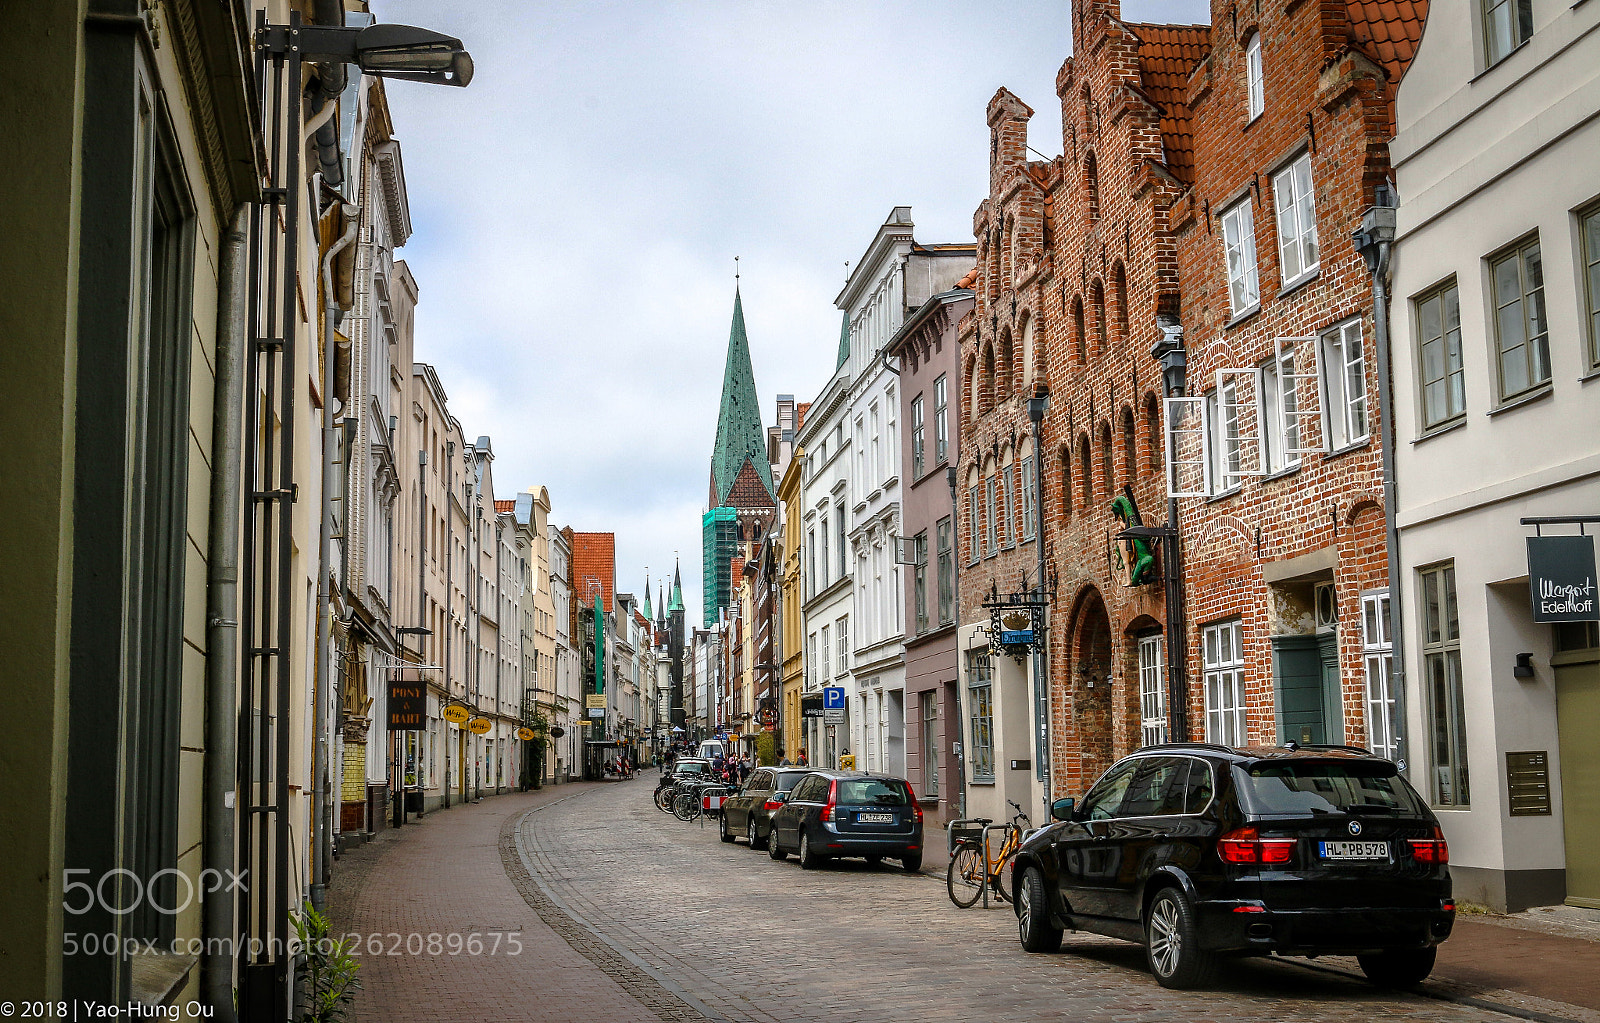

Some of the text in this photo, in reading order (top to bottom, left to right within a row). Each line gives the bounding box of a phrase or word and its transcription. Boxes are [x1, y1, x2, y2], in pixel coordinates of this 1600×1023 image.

[1539, 576, 1596, 605] Margrit
[1541, 600, 1593, 614] Edelhoff
[392, 687, 421, 698] PONY
[828, 690, 840, 707] P
[403, 701, 411, 711] &
[391, 713, 421, 724] BART
[860, 813, 869, 821] HL
[1326, 843, 1386, 856] HL PB 578
